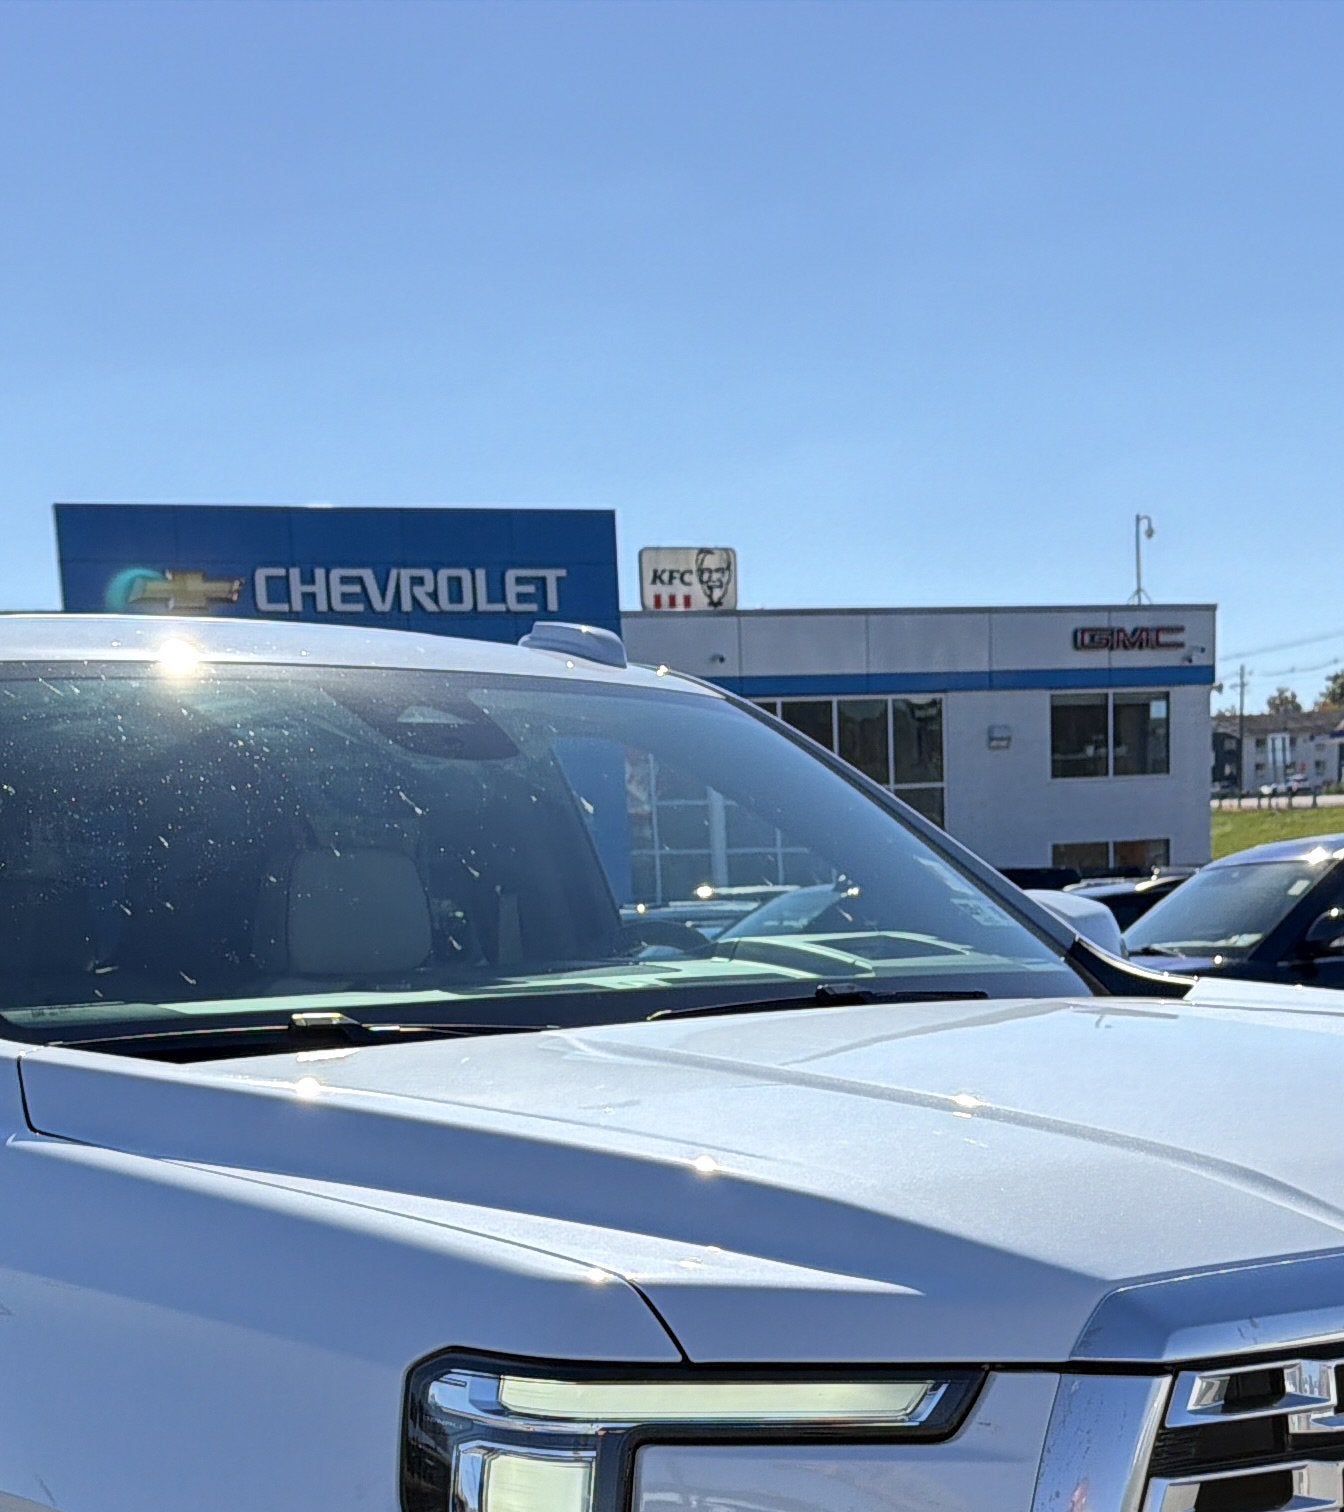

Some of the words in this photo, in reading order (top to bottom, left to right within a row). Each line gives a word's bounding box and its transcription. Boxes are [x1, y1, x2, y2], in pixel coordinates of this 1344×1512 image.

[255, 567, 567, 613] CHEVROLET
[650, 568, 693, 586] KFC
[1073, 625, 1185, 651] GMC
